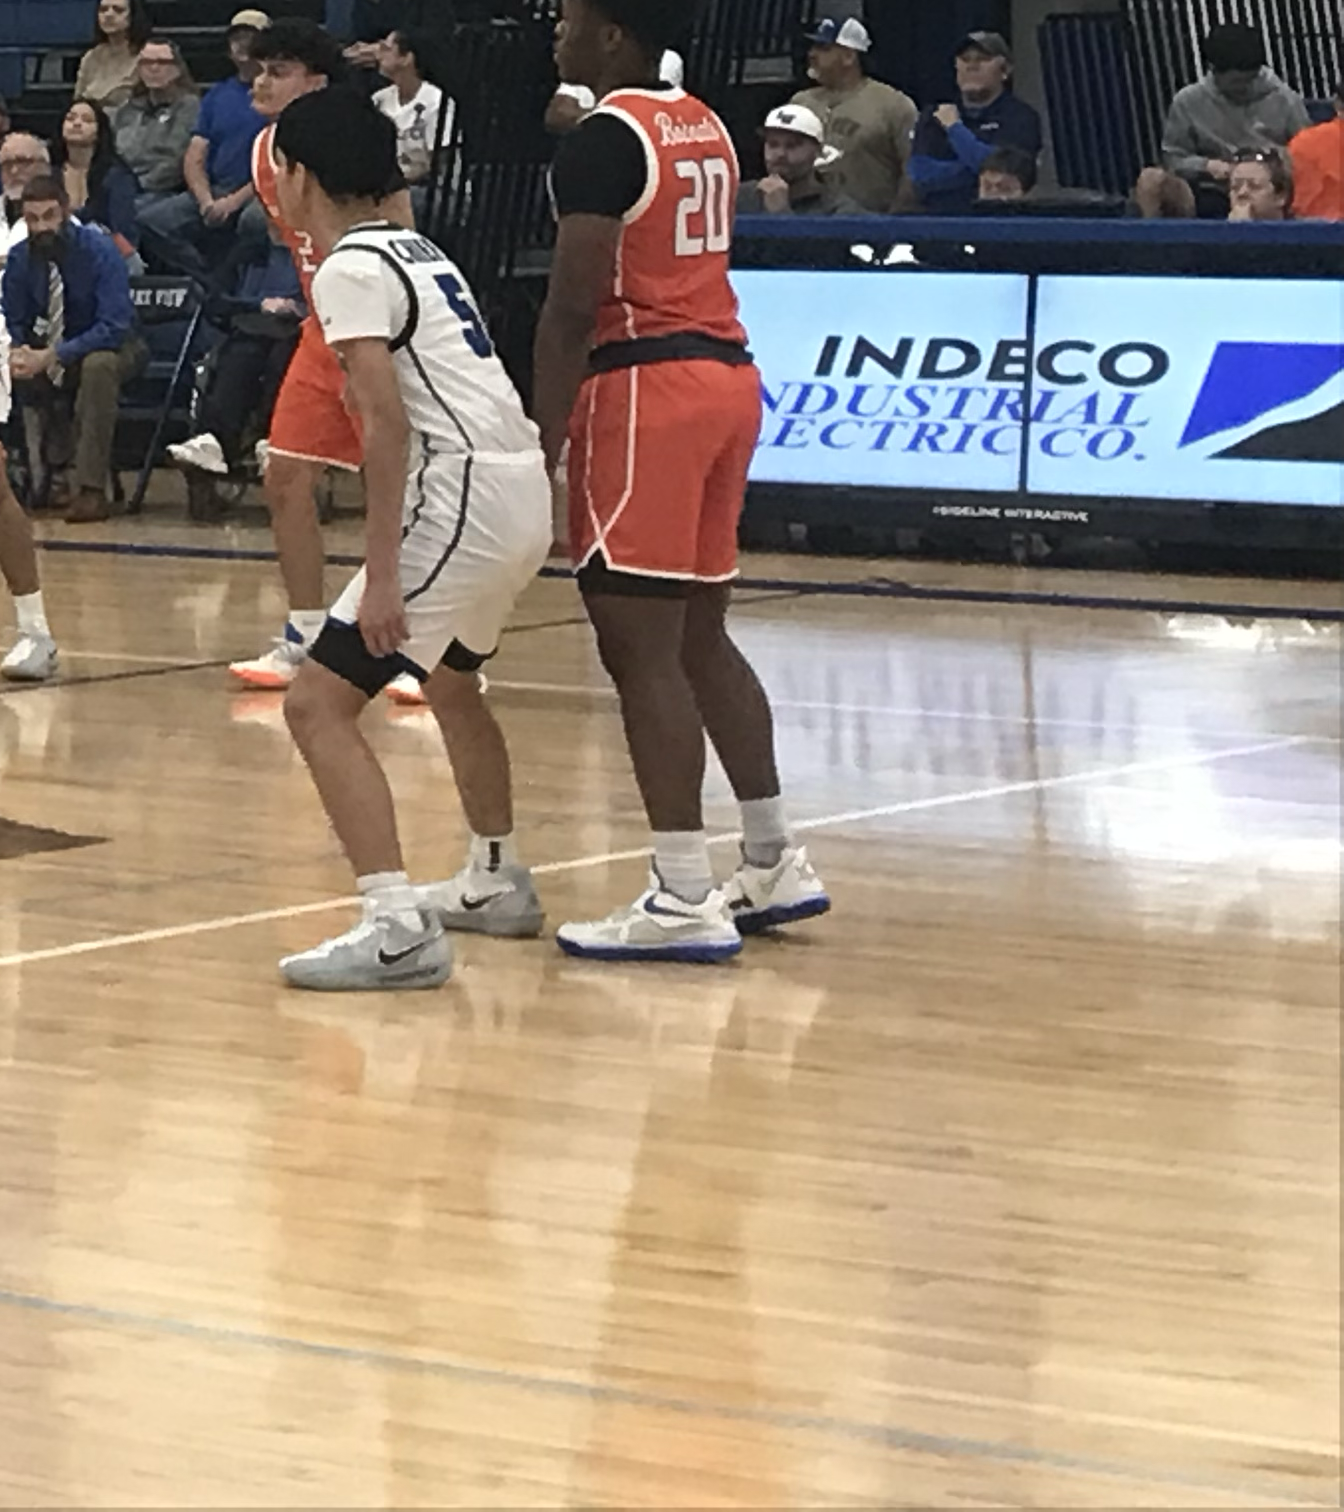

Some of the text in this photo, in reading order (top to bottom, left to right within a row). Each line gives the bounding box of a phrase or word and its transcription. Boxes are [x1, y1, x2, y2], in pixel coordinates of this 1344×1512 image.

[675, 157, 730, 256] 20
[433, 273, 493, 358] 5
[813, 334, 1170, 388] INDECO
[762, 381, 1152, 427] NDUSTRIAL
[758, 418, 1146, 462] ECTRIC CO.
